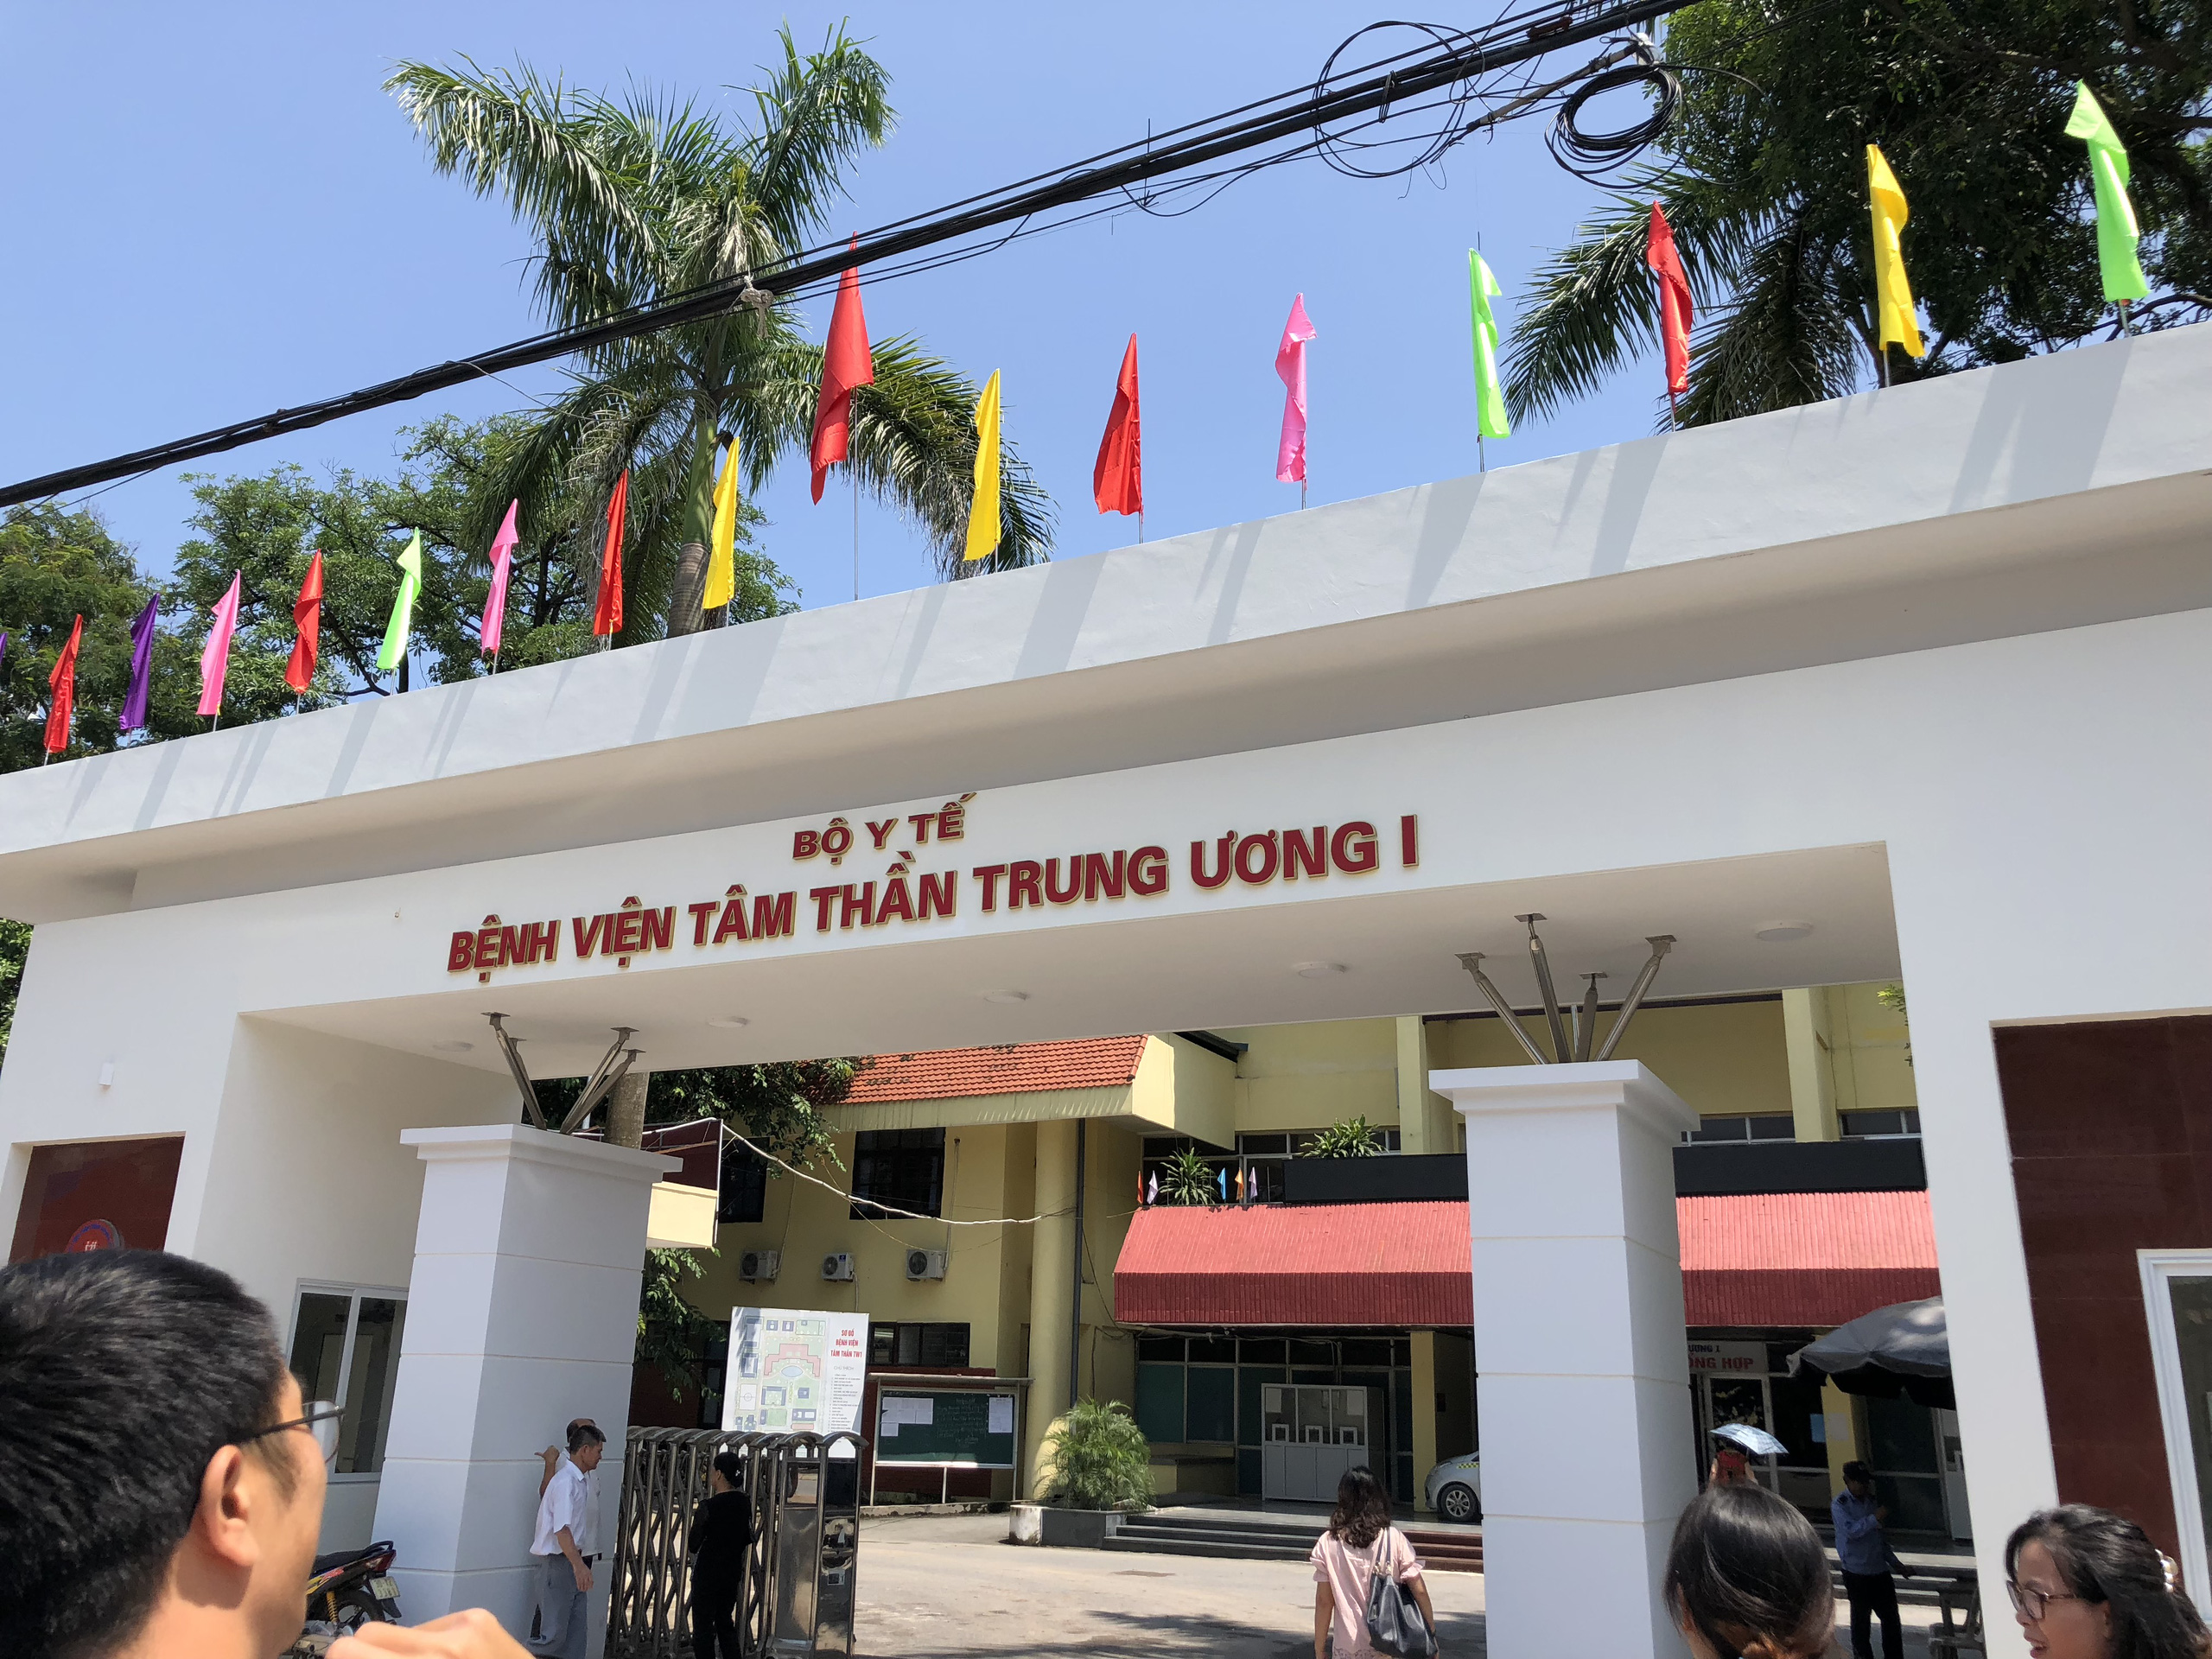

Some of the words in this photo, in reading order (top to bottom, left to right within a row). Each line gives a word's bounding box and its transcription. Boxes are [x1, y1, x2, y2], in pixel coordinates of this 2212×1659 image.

[792, 817, 854, 865] BỘ
[865, 817, 898, 849] Y
[908, 791, 977, 844] TẾ
[447, 914, 561, 983] BỆNH
[572, 896, 677, 968] VIỆN
[688, 883, 797, 946] TÂM
[810, 850, 958, 932] THẦN
[972, 845, 1169, 913] TRUNG
[1191, 820, 1380, 890] ƯƠNG
[1400, 814, 1420, 868] I
